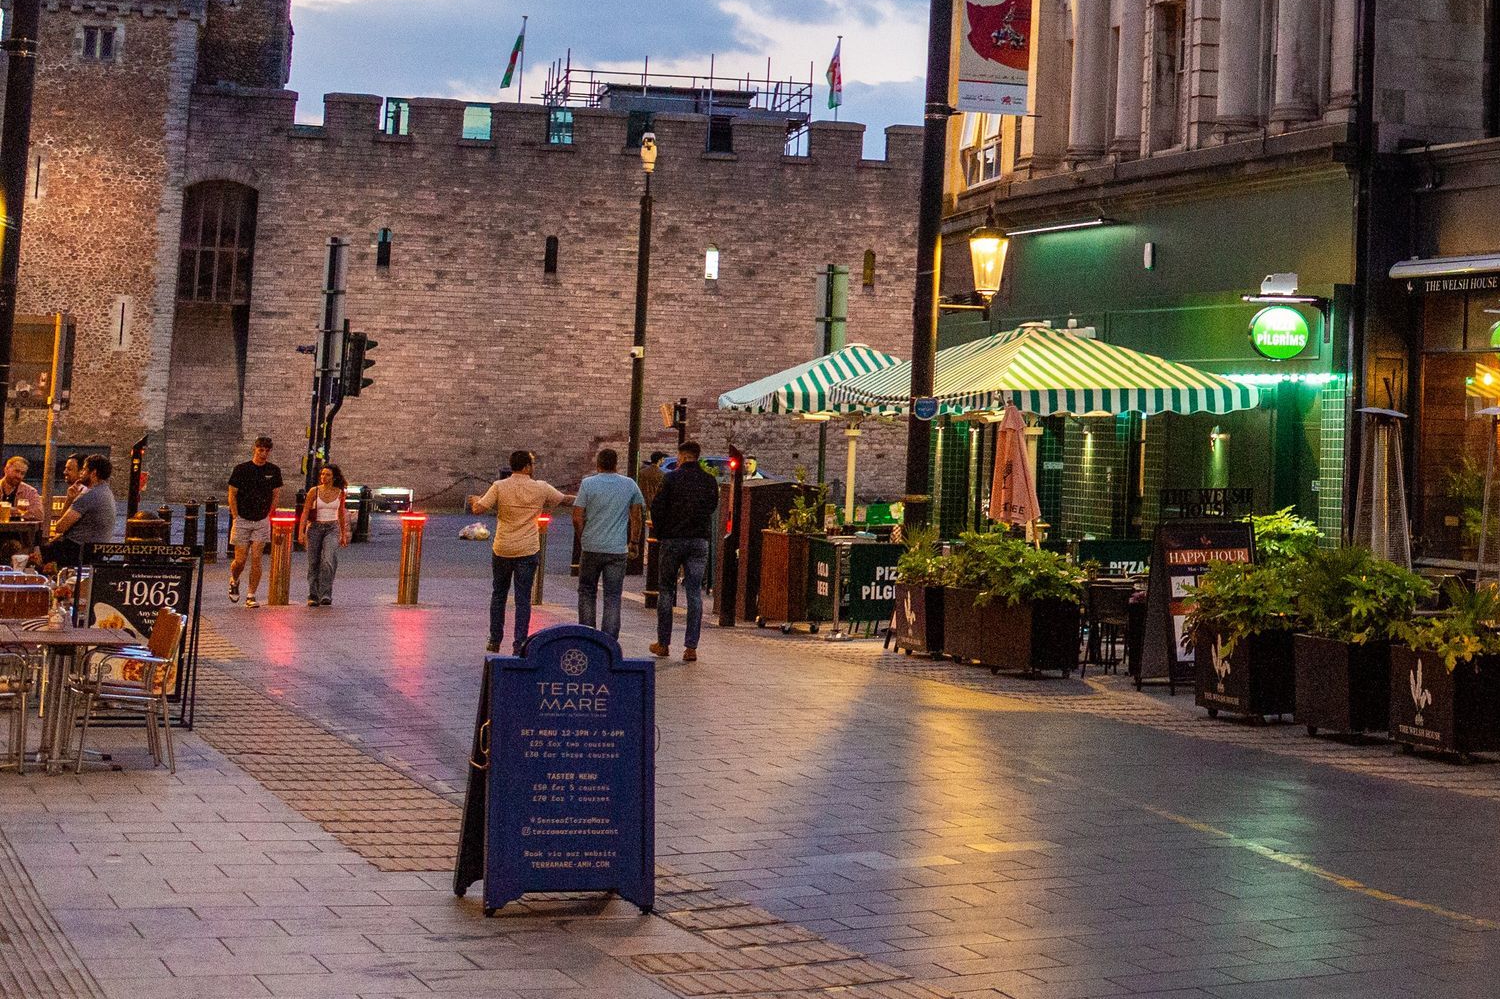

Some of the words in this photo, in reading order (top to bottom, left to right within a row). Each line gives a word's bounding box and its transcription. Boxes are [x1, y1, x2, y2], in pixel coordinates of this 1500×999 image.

[1426, 280, 1440, 292] THE
[1442, 279, 1469, 291] WELSH
[1470, 277, 1498, 289] HOUSE
[1161, 489, 1190, 505] THE
[1198, 488, 1253, 503] WELSH
[1180, 504, 1231, 518] HOUSE
[93, 544, 191, 556] PIZZAEXPRESS
[1169, 551, 1207, 563] HAPPY
[1210, 550, 1246, 562] HOUR
[1109, 561, 1144, 575] PIZZA
[117, 581, 180, 606] £19.65
[536, 682, 610, 695] TERRA
[539, 698, 608, 711] MARE
[521, 729, 535, 737] SET
[538, 729, 558, 737] MENU
[547, 740, 561, 748] for
[566, 740, 580, 748] two
[584, 740, 615, 748] courses
[588, 751, 619, 759] courses
